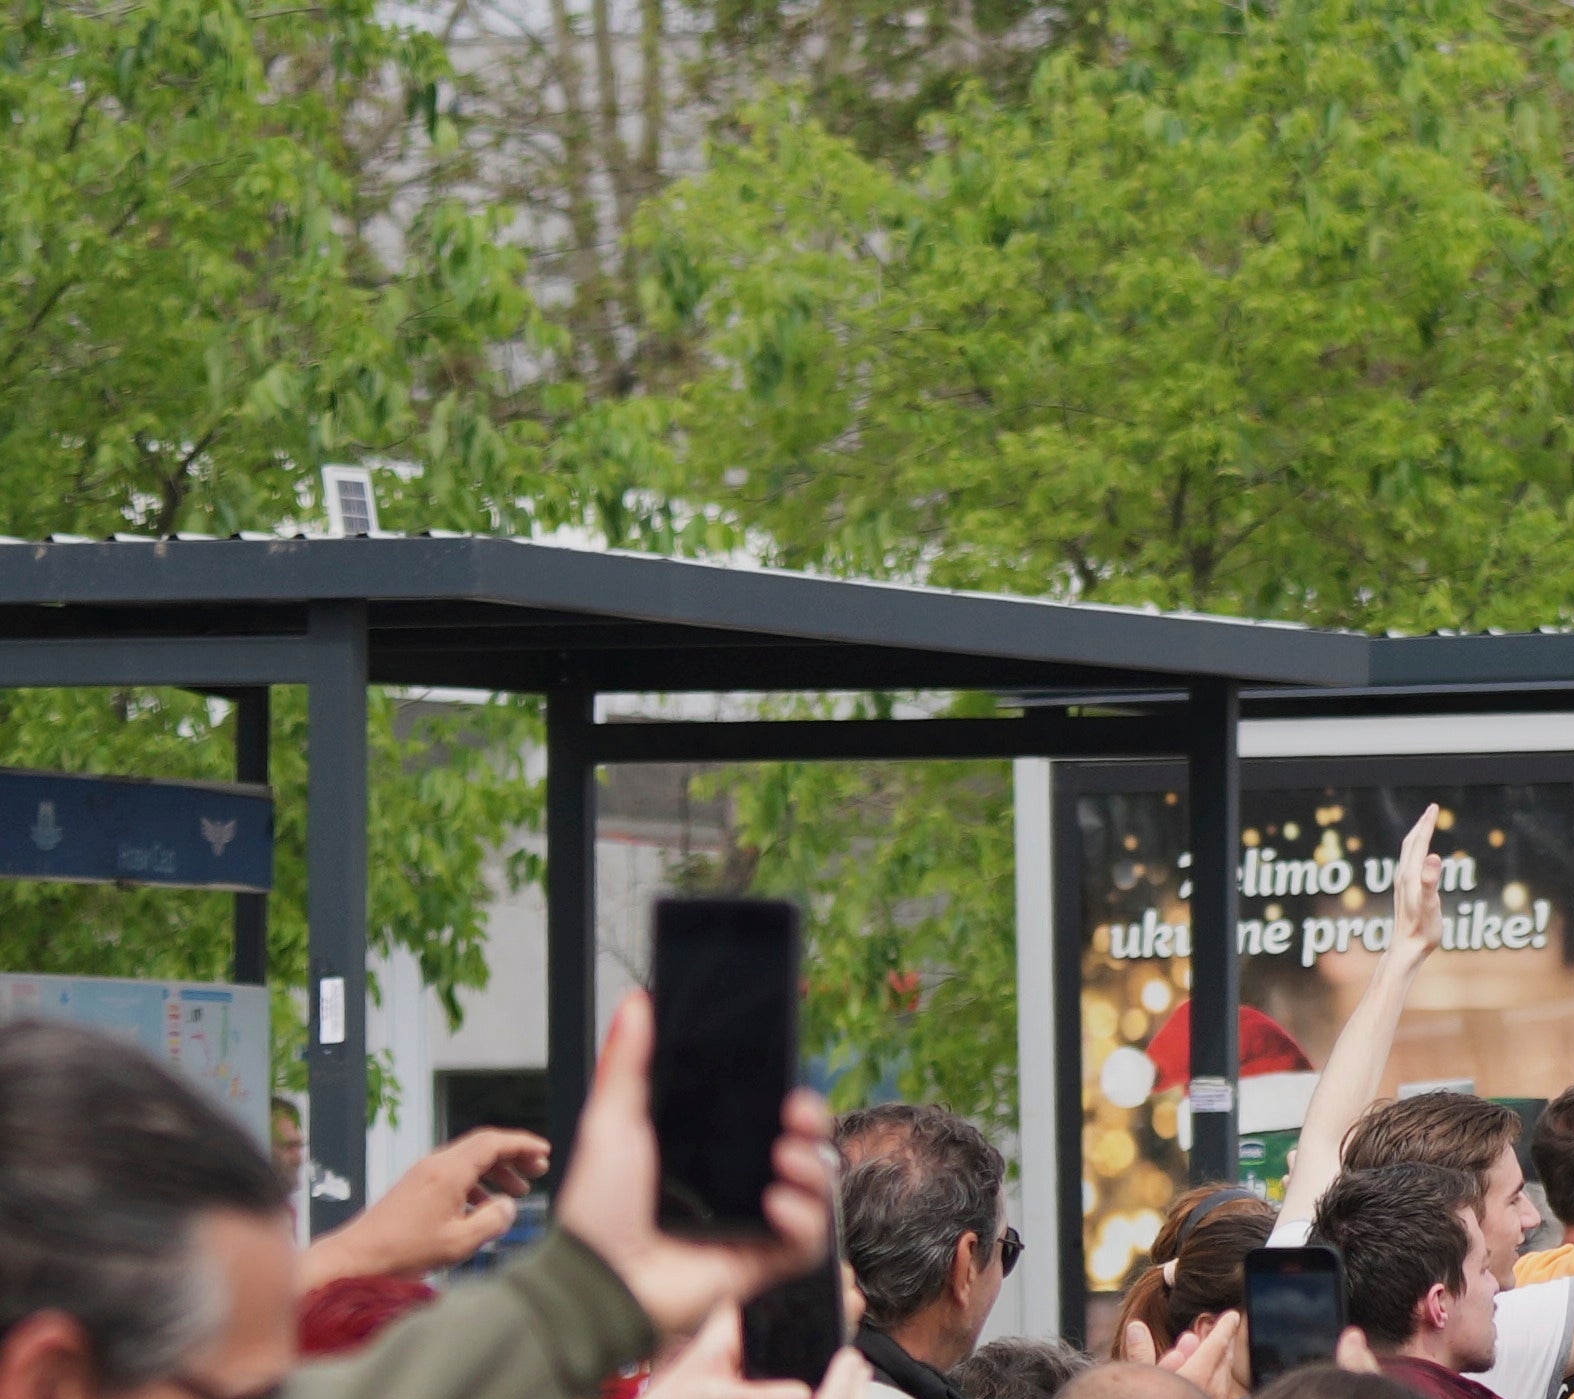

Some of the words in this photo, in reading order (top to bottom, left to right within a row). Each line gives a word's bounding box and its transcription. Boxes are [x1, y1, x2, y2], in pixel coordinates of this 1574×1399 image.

[1364, 855, 1477, 893] vm
[1110, 908, 1293, 960] ukune
[1302, 899, 1551, 967] praike!
